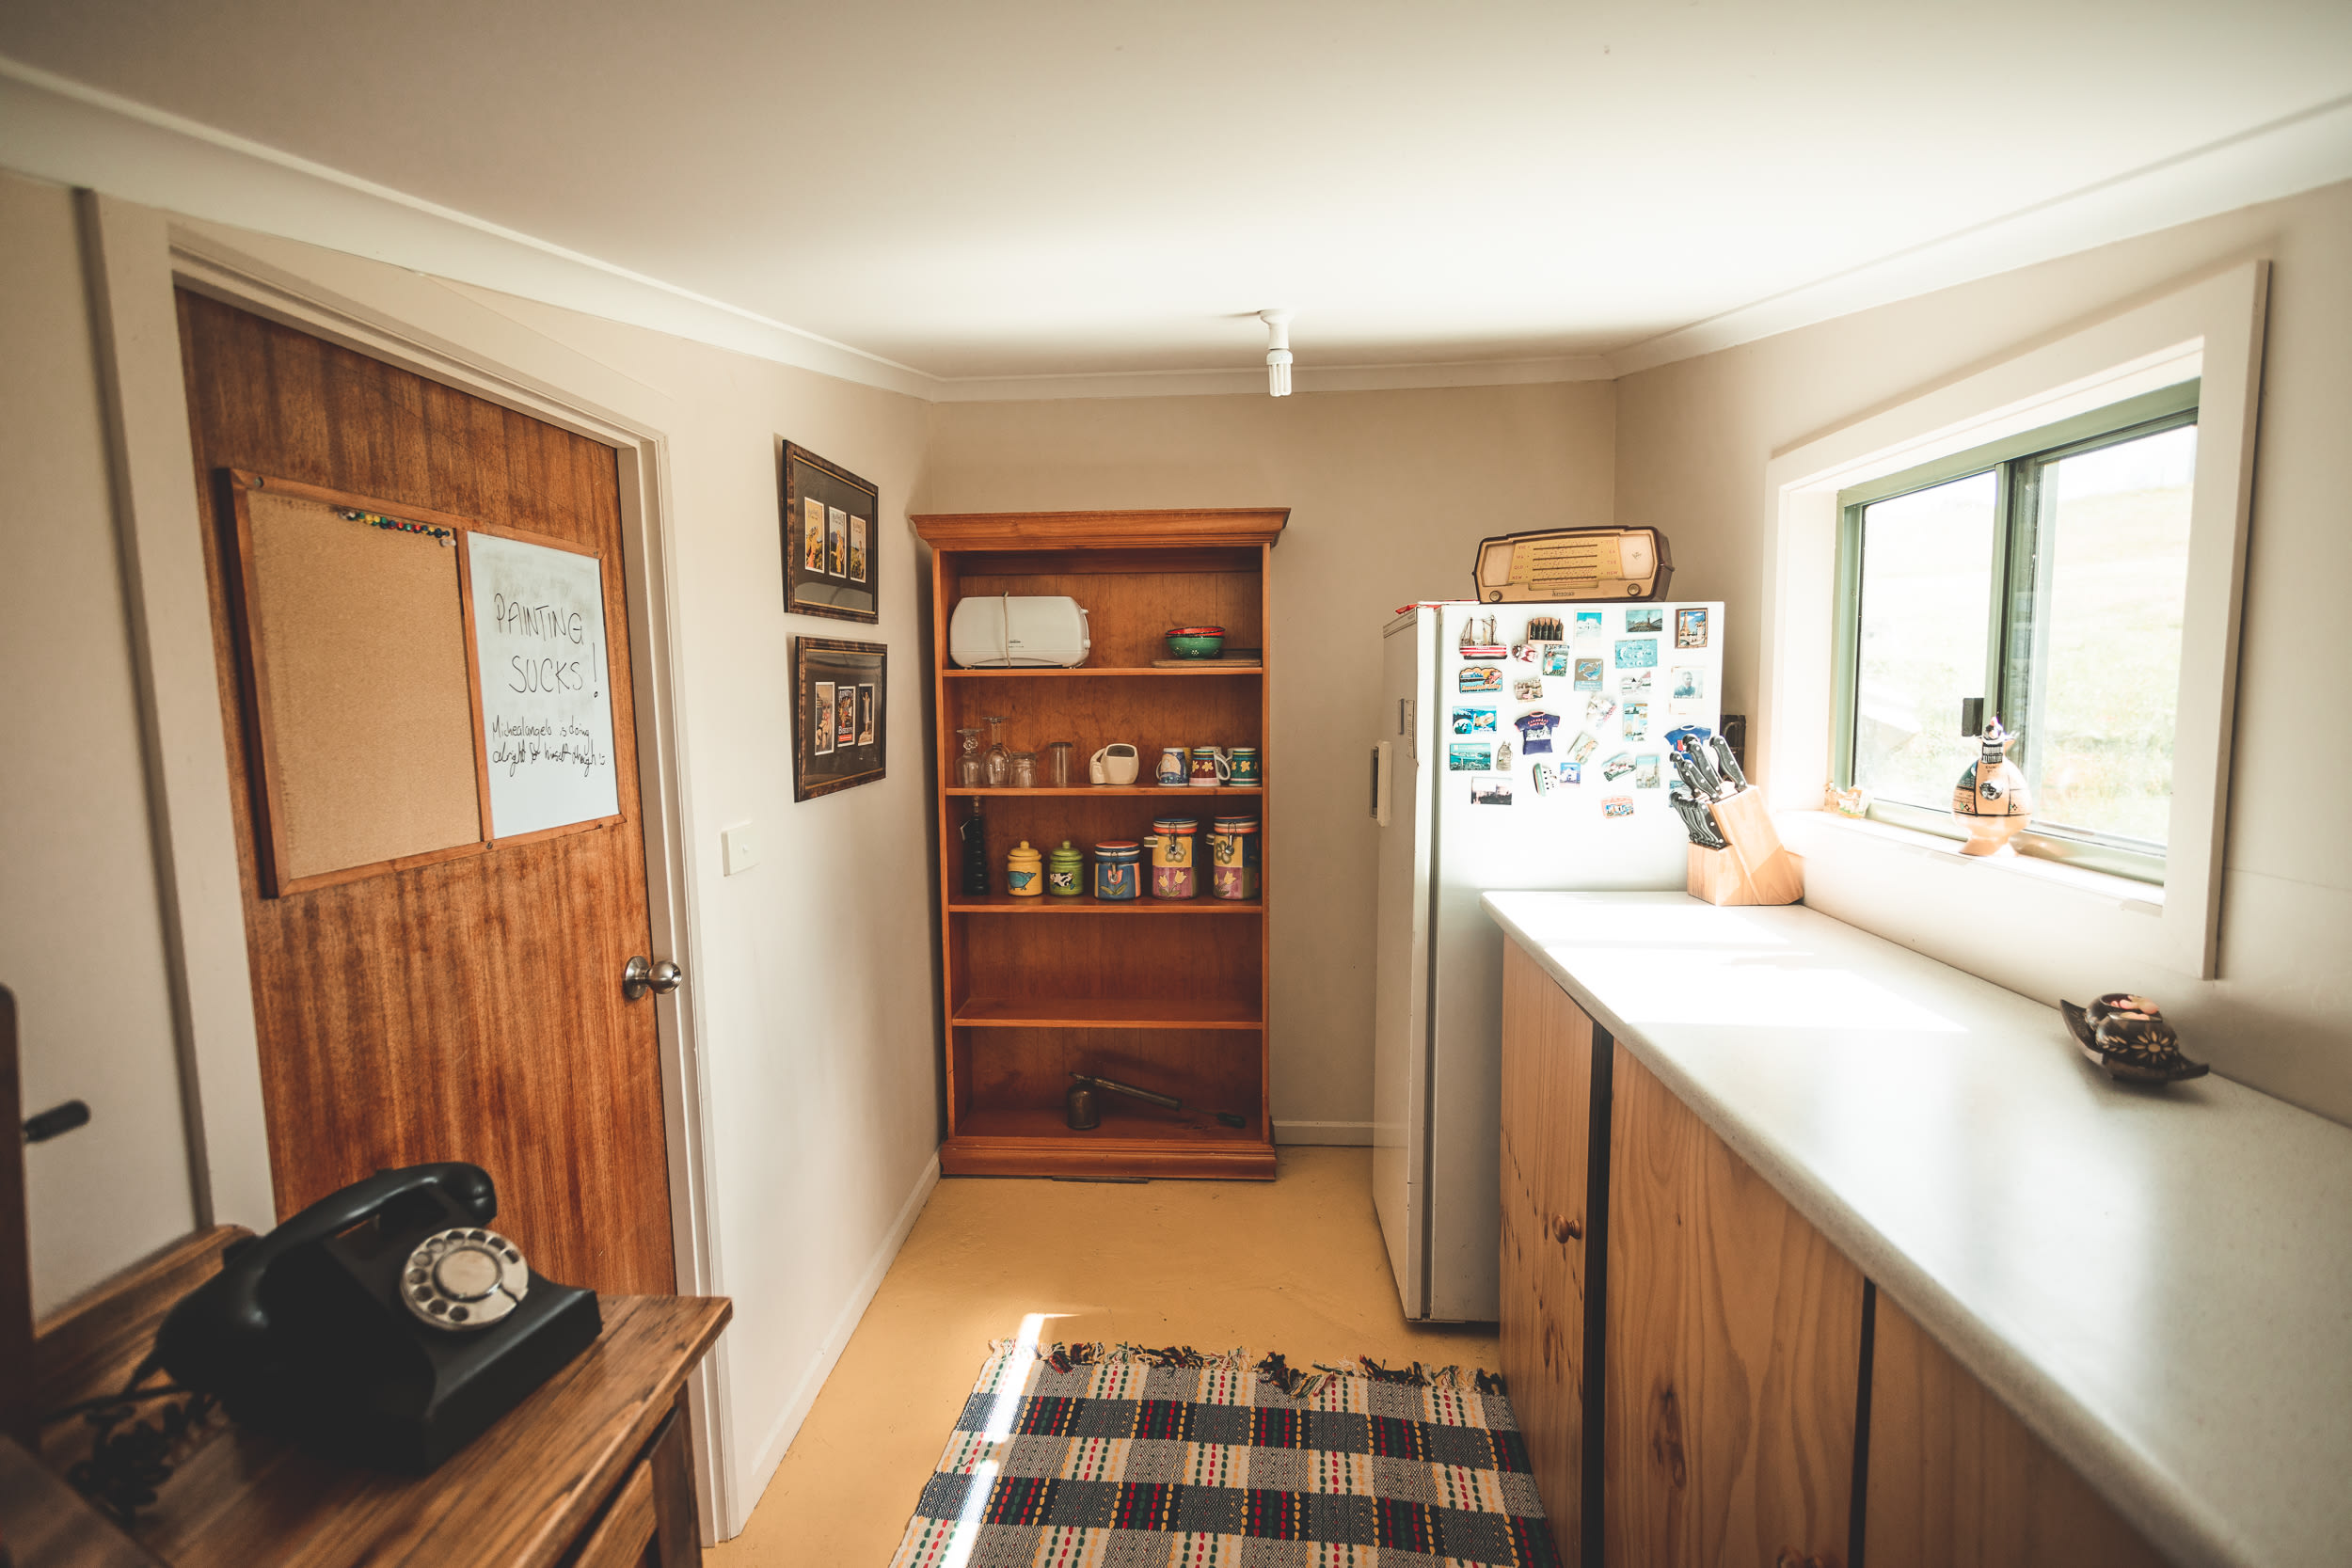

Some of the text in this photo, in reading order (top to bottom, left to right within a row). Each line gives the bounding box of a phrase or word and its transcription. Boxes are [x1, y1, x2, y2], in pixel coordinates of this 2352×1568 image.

[494, 593, 583, 645] PAINTING
[568, 715, 590, 755] doing
[492, 738, 527, 777] alright
[572, 738, 596, 777] though
